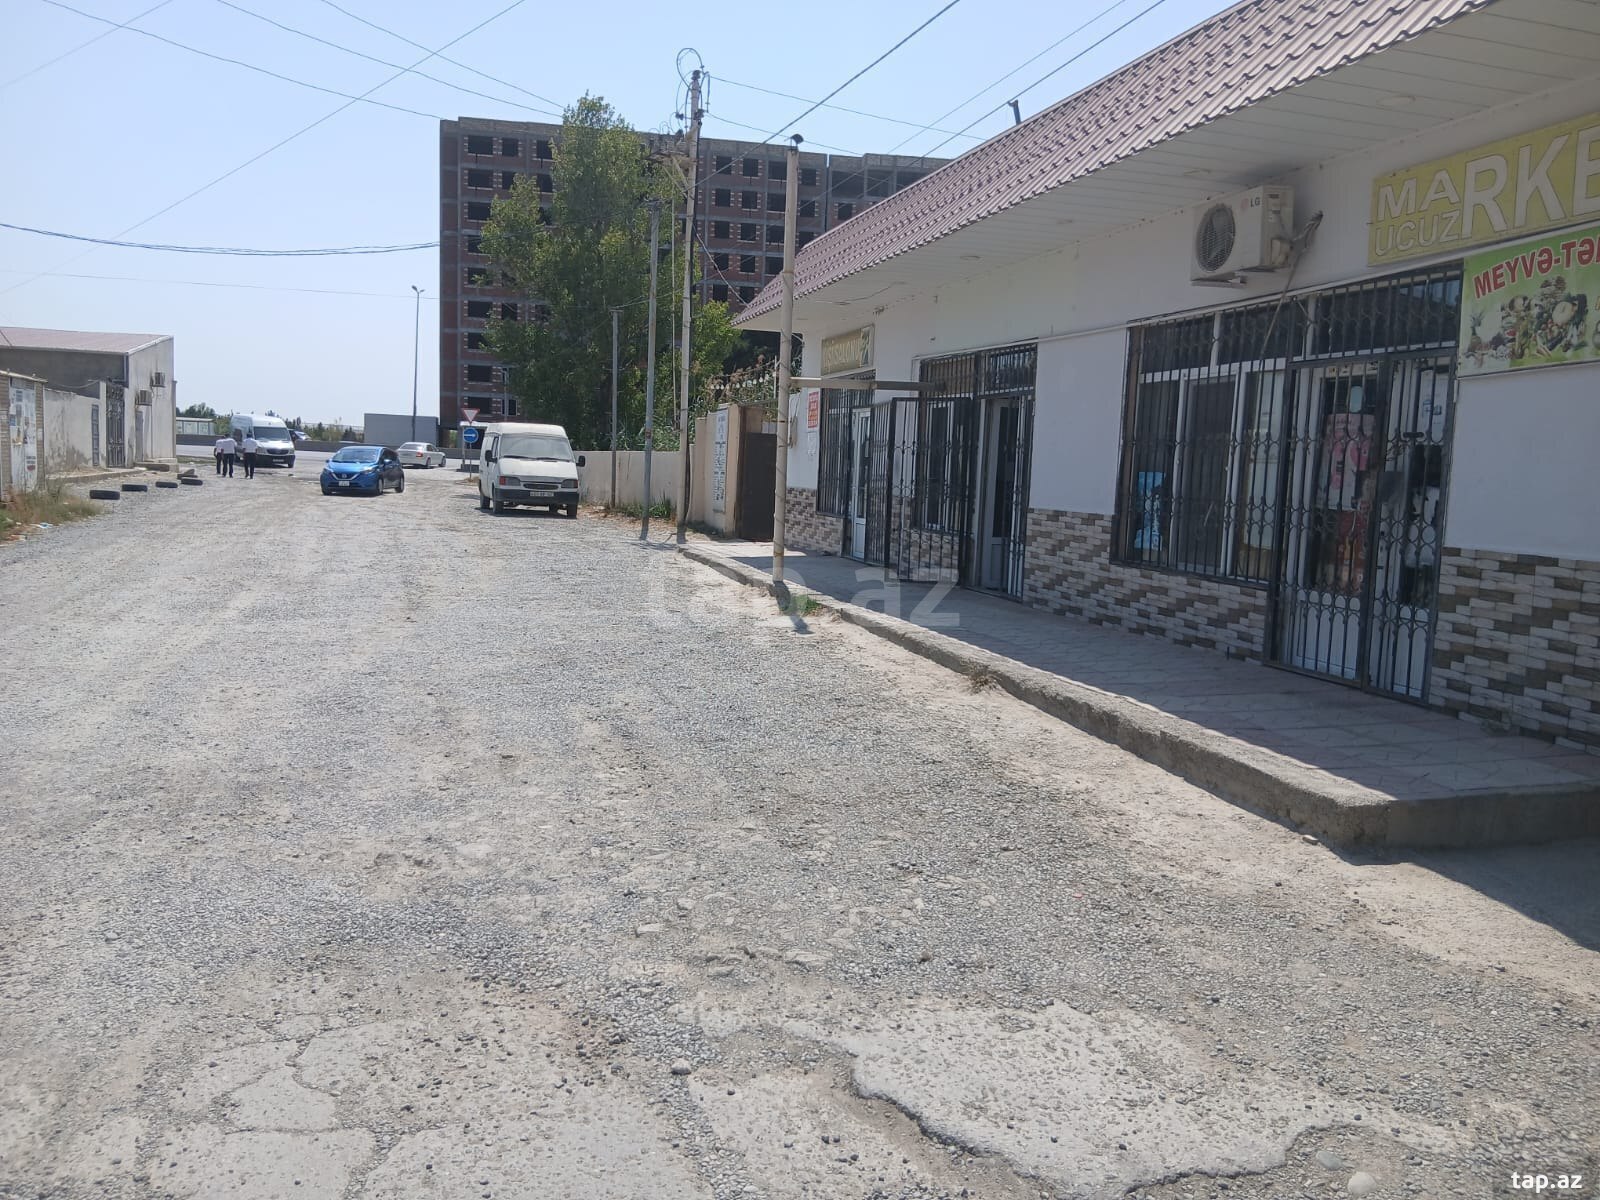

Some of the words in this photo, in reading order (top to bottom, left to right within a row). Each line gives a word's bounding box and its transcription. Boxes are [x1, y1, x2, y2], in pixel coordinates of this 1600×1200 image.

[1250, 197, 1261, 208] LG
[1375, 208, 1462, 257] UCUZ
[1473, 235, 1600, 299] MEYVƏ-TƏ
